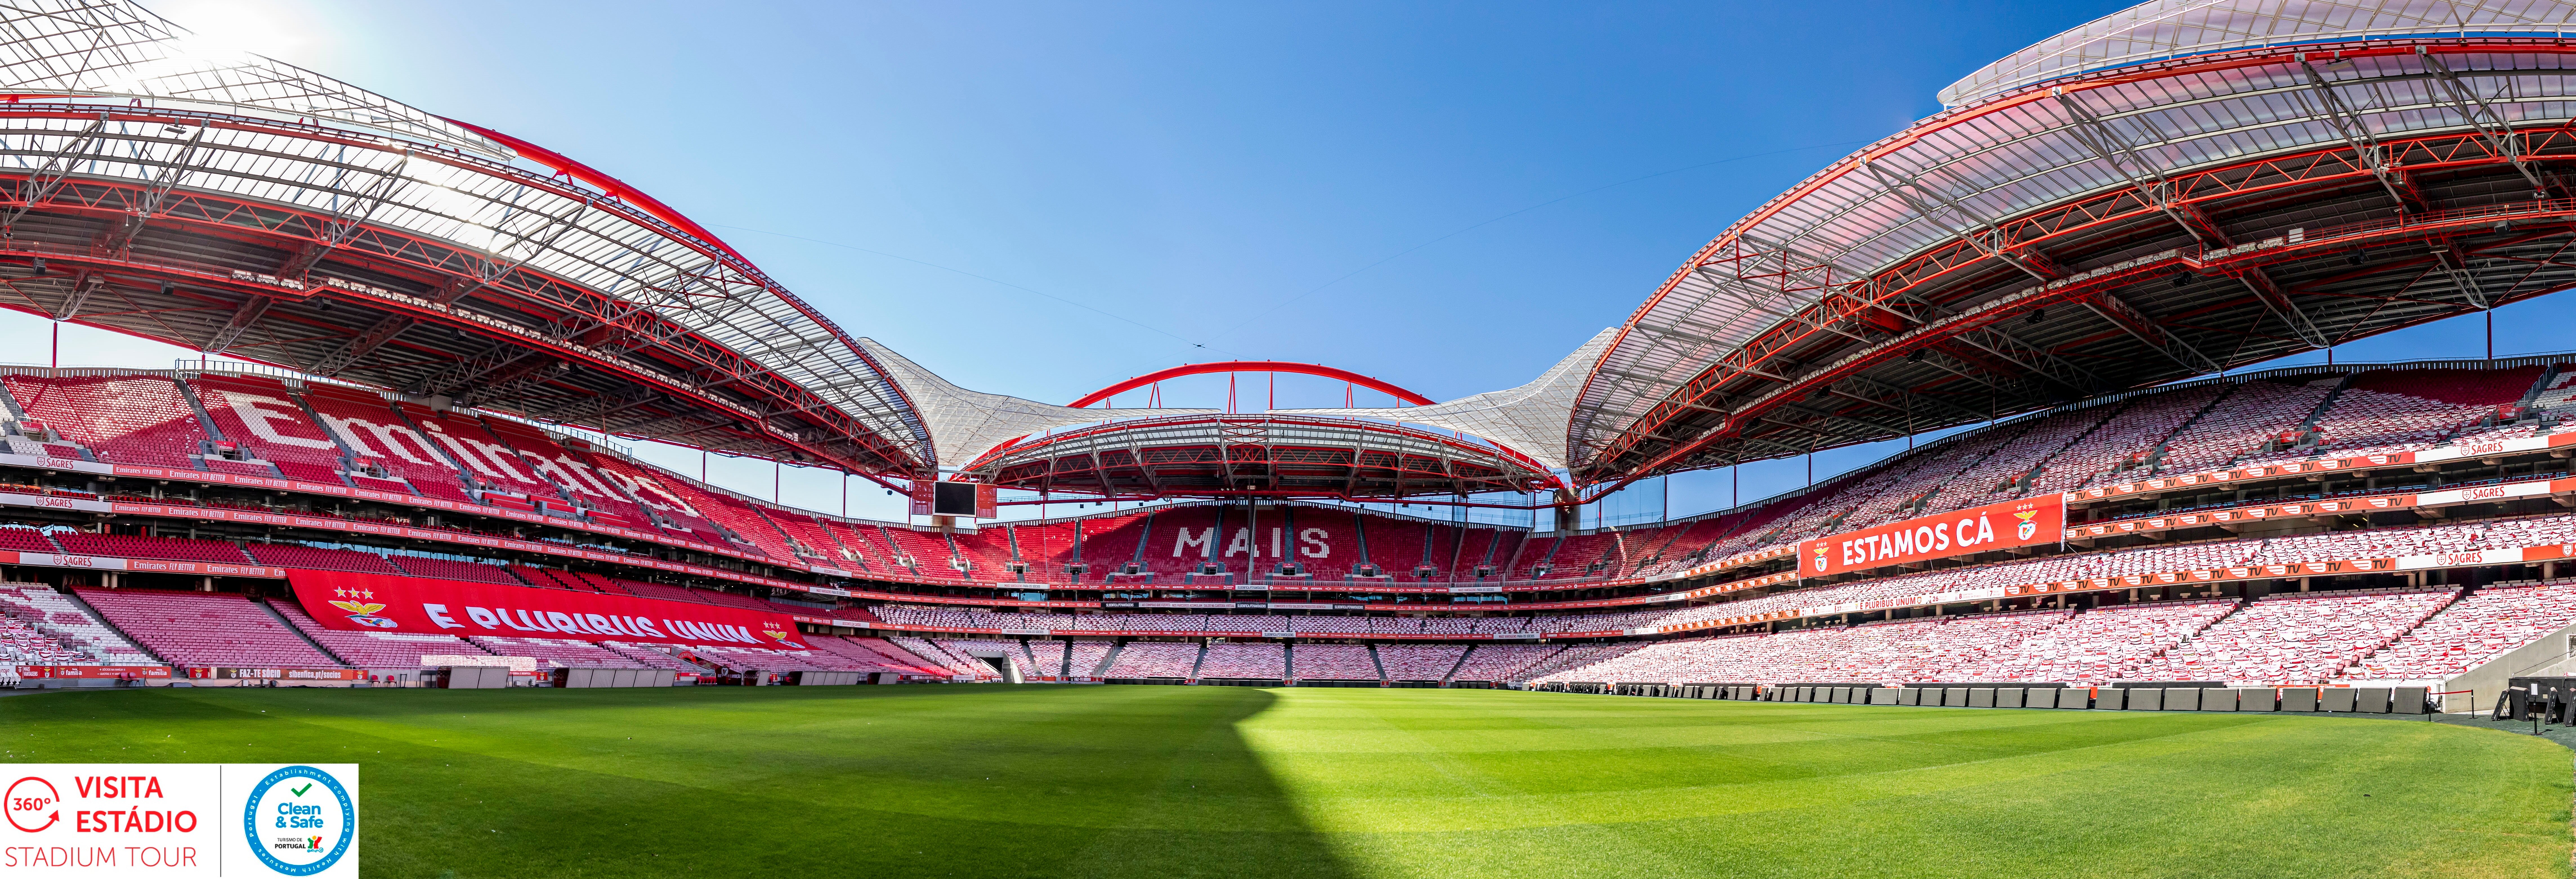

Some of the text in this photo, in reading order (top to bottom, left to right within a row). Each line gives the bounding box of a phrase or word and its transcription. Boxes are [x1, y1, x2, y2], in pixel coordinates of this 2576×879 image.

[2471, 441, 2503, 455] SAGRES
[47, 458, 73, 469] SAGRES
[169, 470, 199, 479] Emirates
[235, 476, 263, 485] Emirates
[297, 483, 323, 491] Emirates
[355, 490, 380, 498] Emirates
[2473, 486, 2505, 500] SAGRES
[45, 497, 72, 508] SAGRES
[409, 497, 432, 505] Emirates
[169, 508, 198, 516] Emirates
[234, 513, 262, 522] Emirates
[1173, 527, 1329, 558] MAIS
[1842, 511, 1994, 566] ESTAMOS CÁ
[63, 557, 92, 567] SAGRES
[2448, 551, 2482, 565] SAGRES
[134, 561, 166, 570] Emirates
[207, 565, 238, 573] Emirates
[1865, 599, 1893, 609] PLURIBUS
[423, 603, 466, 628] E
[240, 668, 341, 680] FAZ-TE SÓCIO slbenfica.pt/socios
